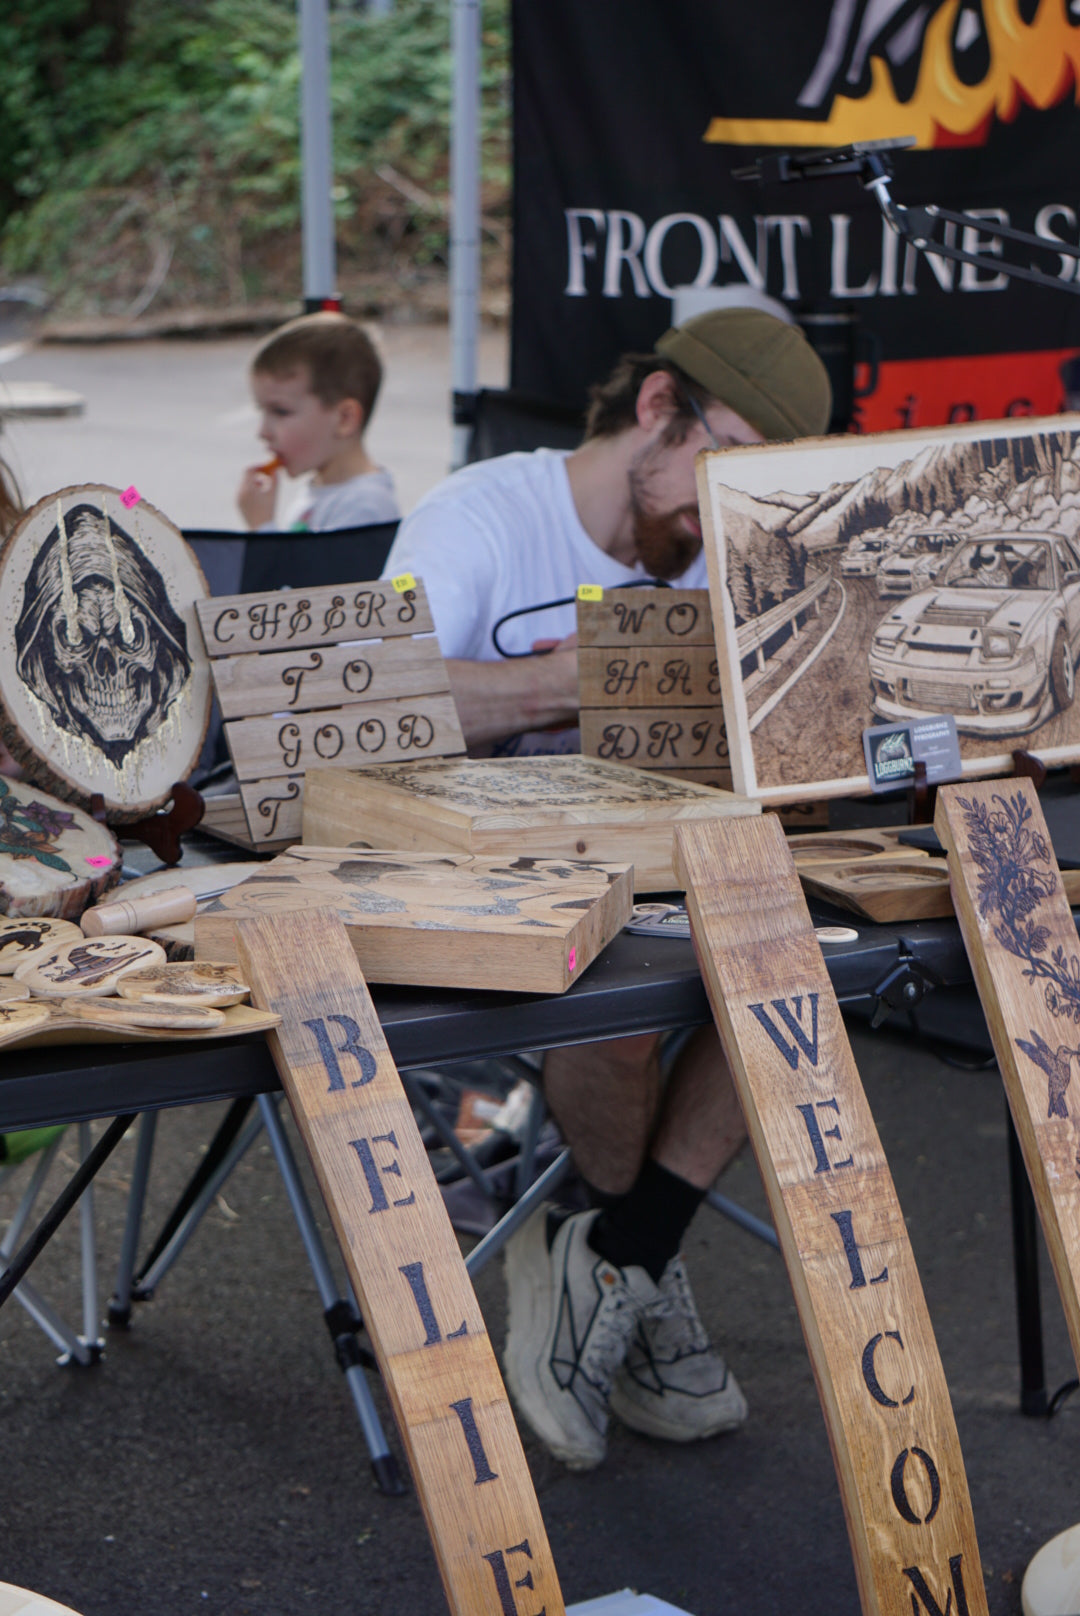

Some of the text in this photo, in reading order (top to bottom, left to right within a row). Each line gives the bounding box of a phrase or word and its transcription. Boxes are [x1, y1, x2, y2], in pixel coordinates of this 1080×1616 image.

[564, 208, 811, 299] FRONT
[830, 207, 1010, 298] LINE
[213, 590, 416, 643] CHEERS
[613, 602, 714, 636] WO
[281, 652, 373, 705] TO
[278, 714, 434, 768] GOOD
[747, 992, 970, 1616] WELCOM
